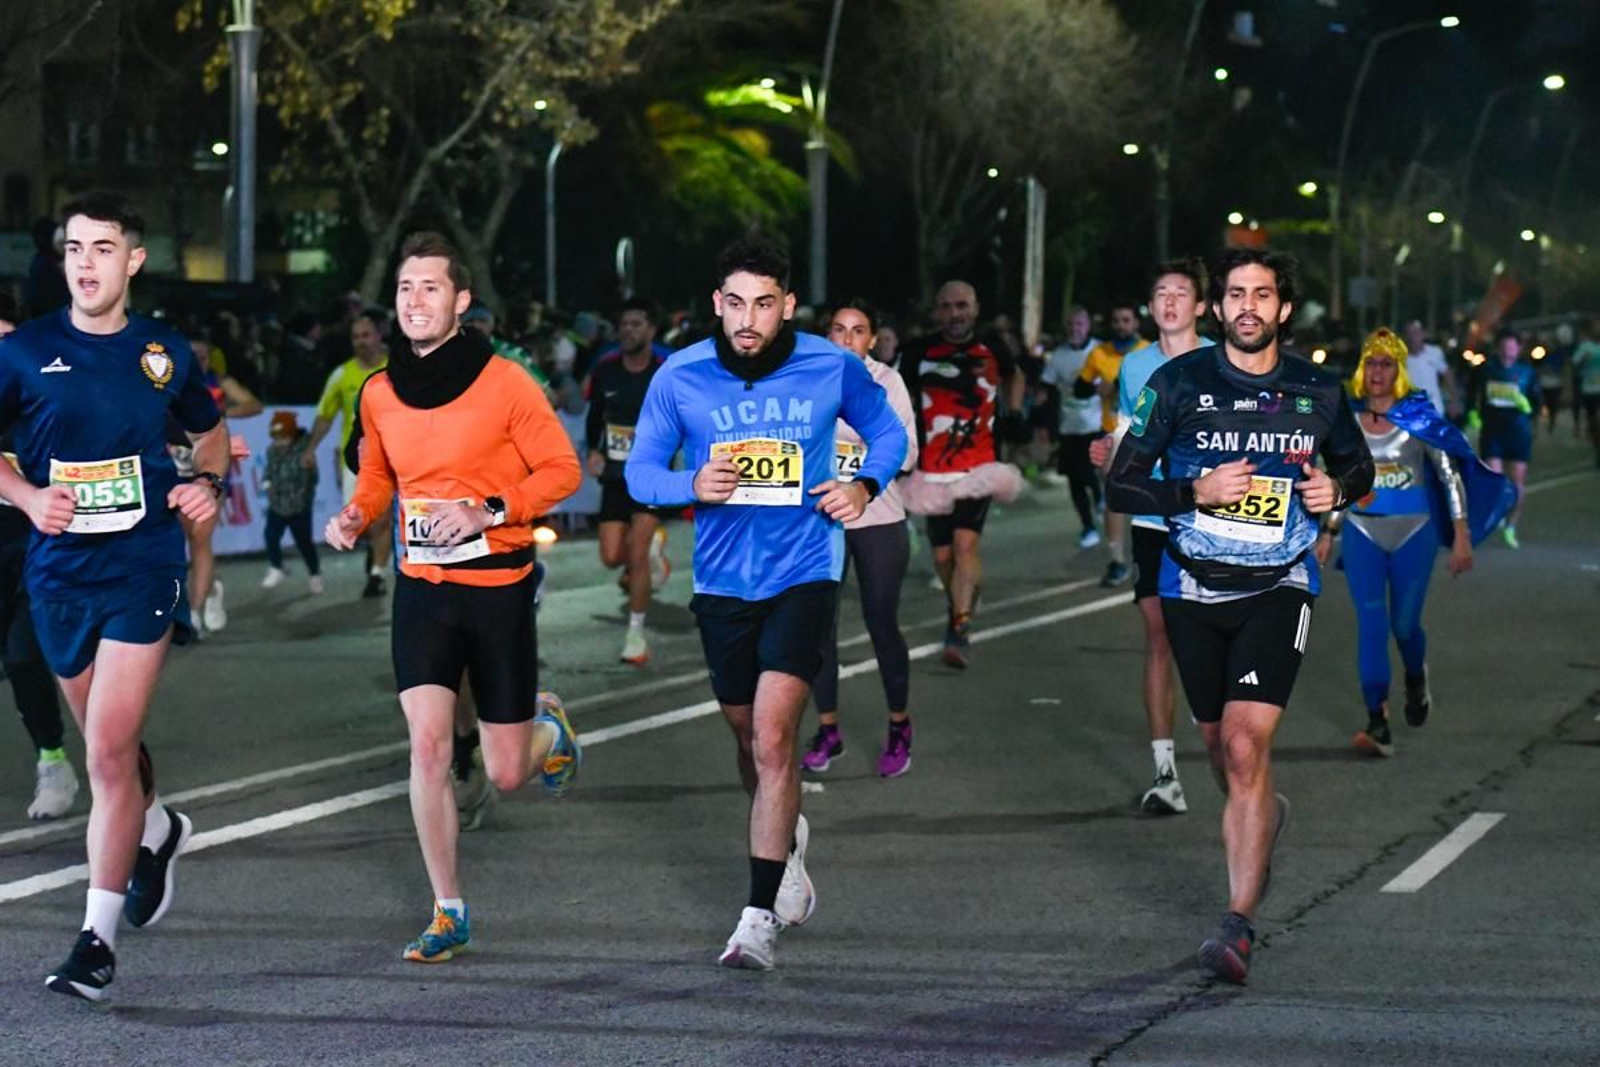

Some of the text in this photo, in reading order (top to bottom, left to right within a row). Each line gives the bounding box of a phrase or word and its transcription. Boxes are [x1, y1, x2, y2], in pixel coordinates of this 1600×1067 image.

[710, 397, 813, 432] UCAM
[1196, 429, 1314, 454] SAN ANTÓN
[737, 457, 790, 480] 201
[836, 455, 862, 470] 74
[74, 480, 134, 507] 053
